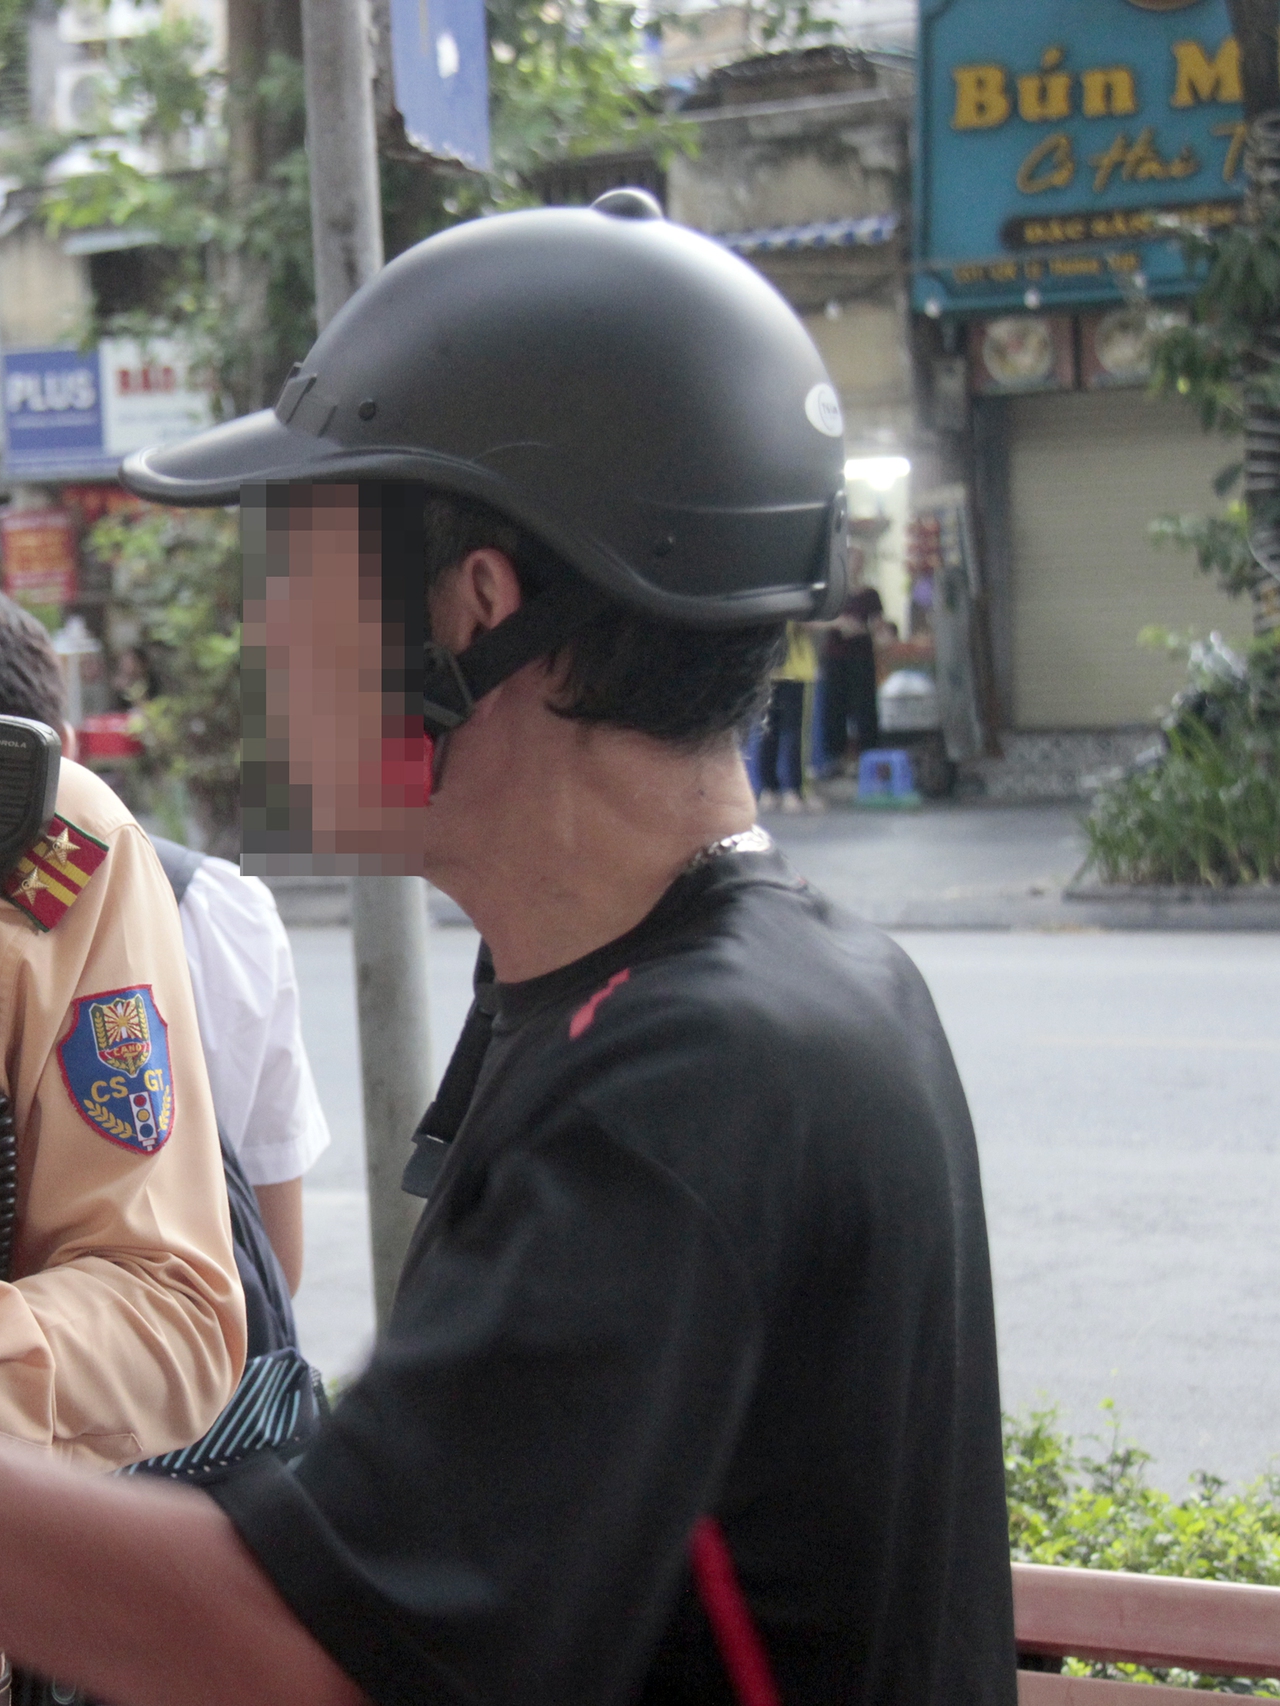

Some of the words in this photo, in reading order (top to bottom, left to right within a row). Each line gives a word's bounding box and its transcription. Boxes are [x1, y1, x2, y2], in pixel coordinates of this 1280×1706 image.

[951, 46, 1137, 130] Bún
[5, 368, 96, 412] PLUS
[113, 1043, 142, 1056] CAND
[91, 1076, 128, 1102] CS
[144, 1069, 164, 1091] GT
